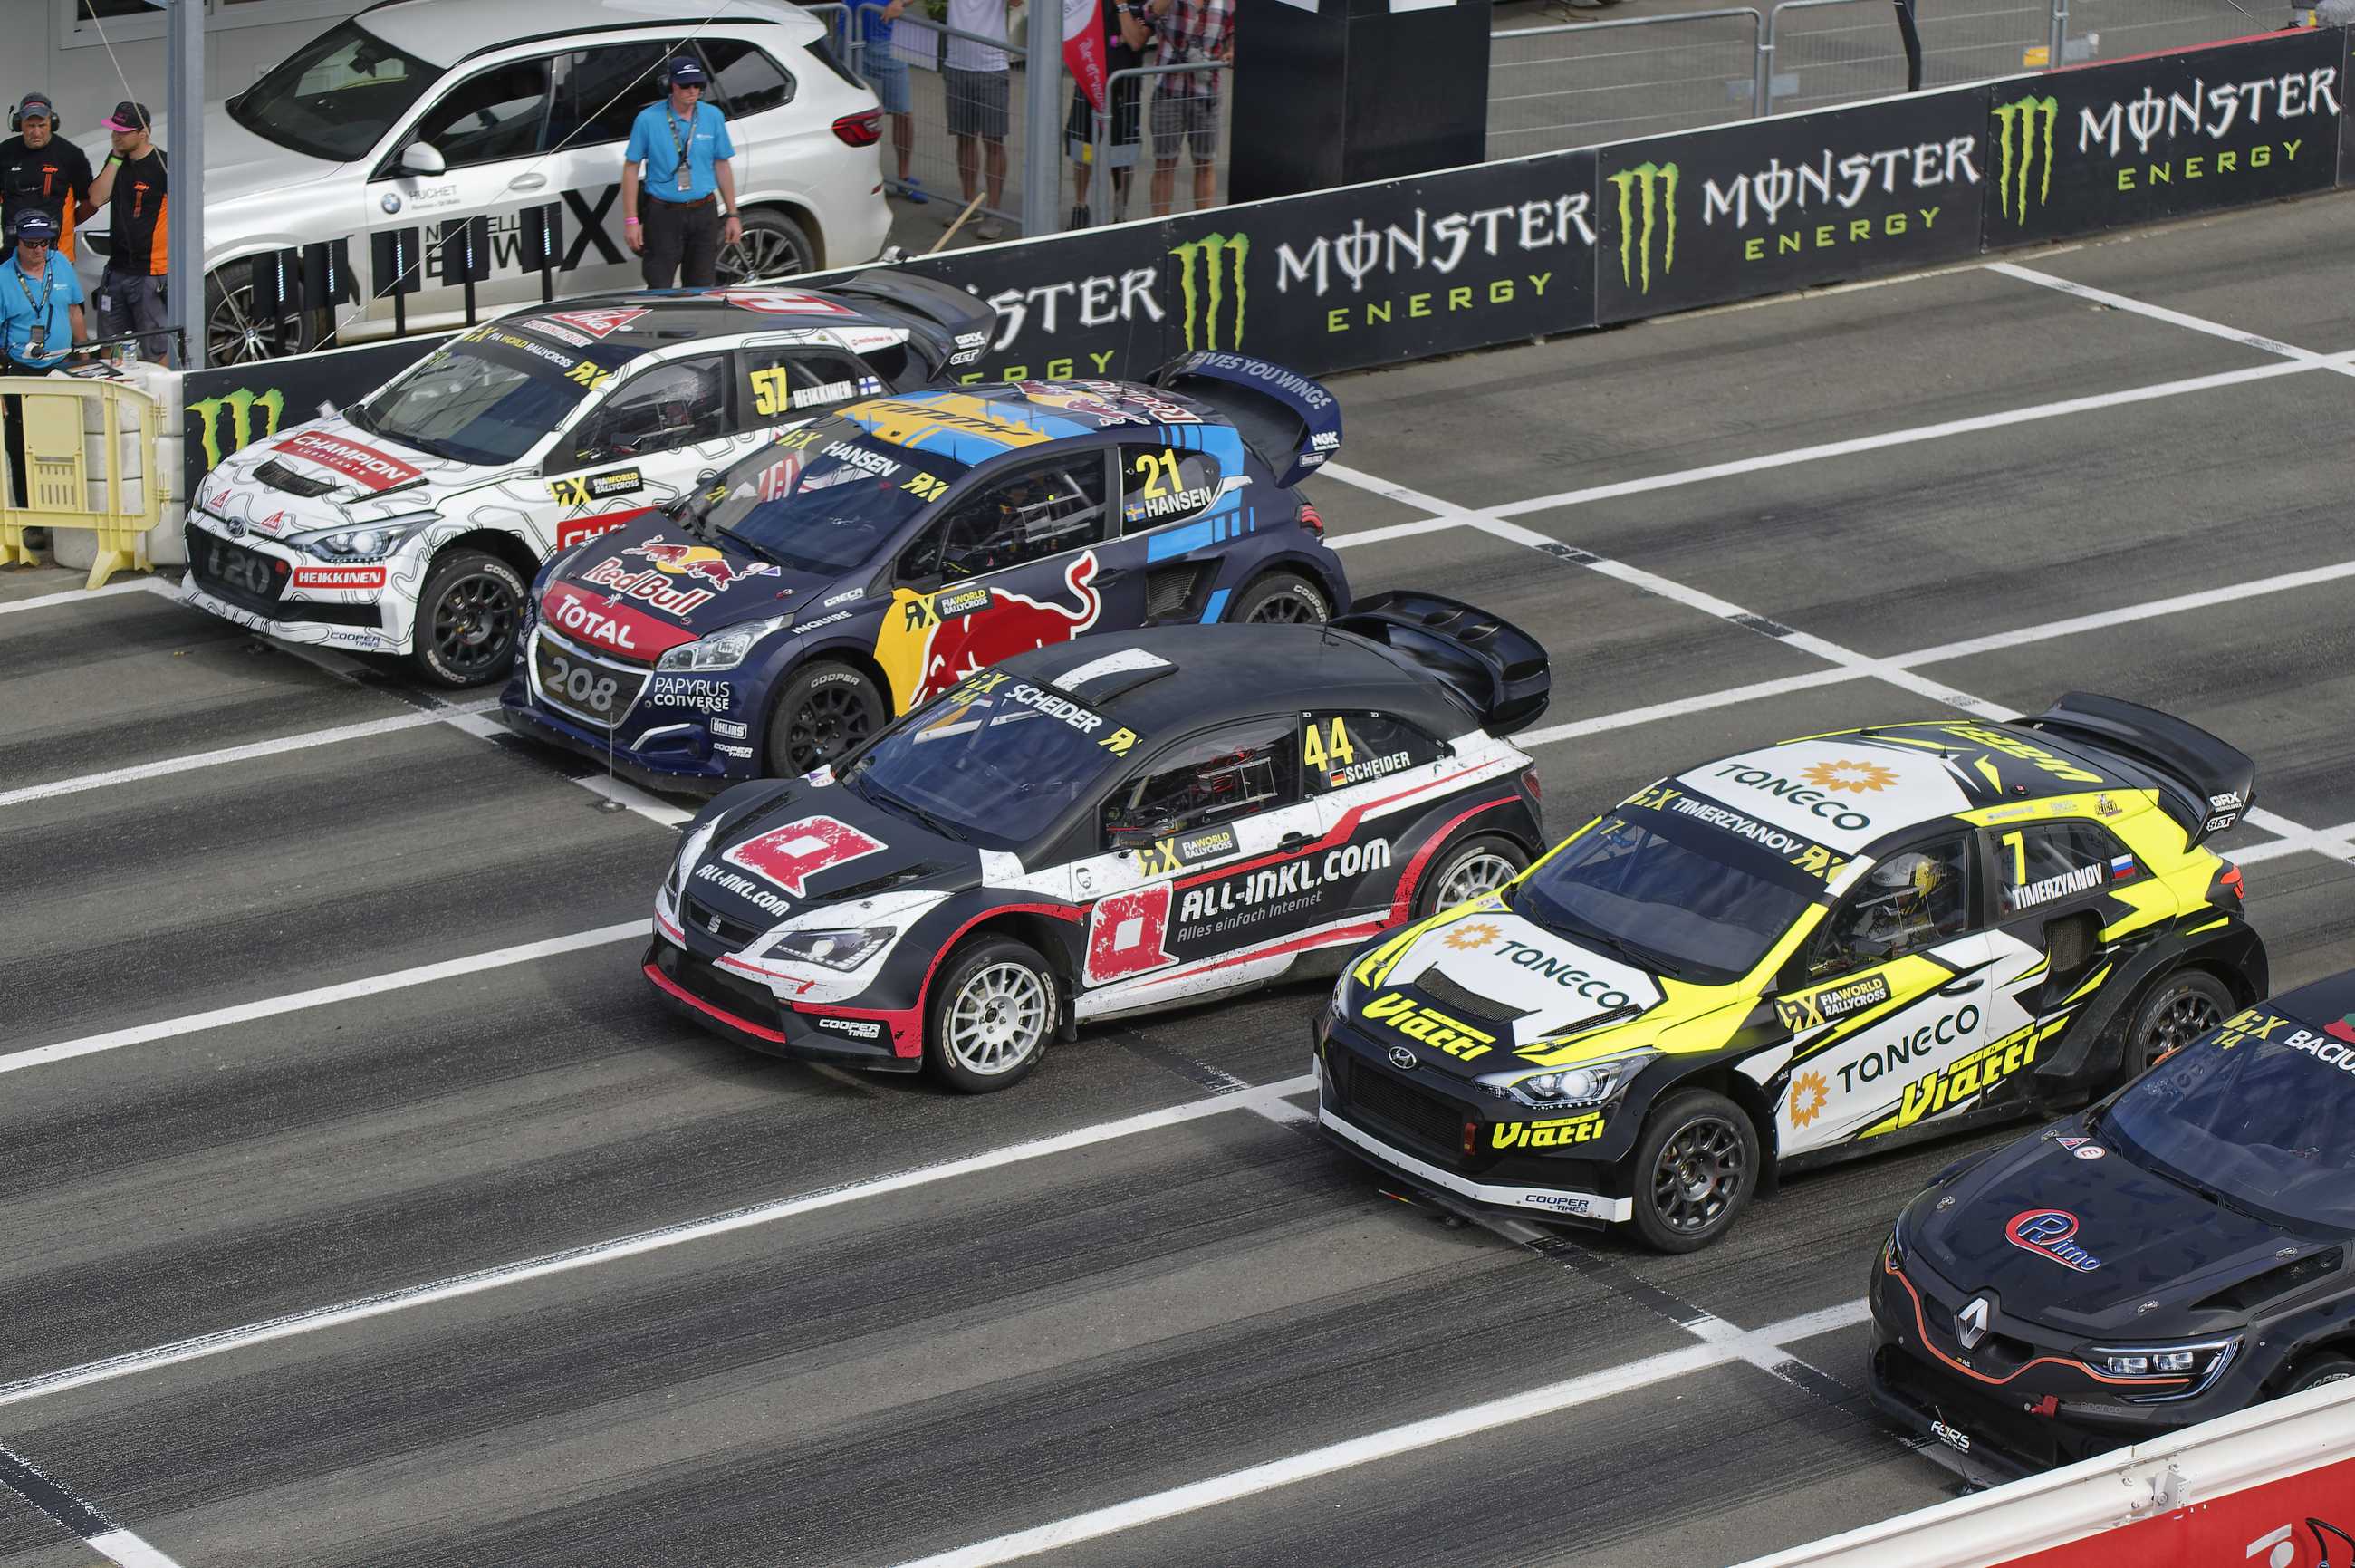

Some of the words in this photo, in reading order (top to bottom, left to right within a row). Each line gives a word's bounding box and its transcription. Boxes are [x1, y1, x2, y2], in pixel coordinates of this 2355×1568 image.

[2117, 139, 2302, 192] ENERGY
[1745, 206, 1941, 262] ENERGY
[1327, 272, 1552, 333] ENERGY
[497, 334, 529, 349] WORLD
[524, 343, 574, 369] RALLYCROSS
[750, 367, 788, 415] 57
[792, 380, 852, 409] HEIKKINEN
[1188, 351, 1244, 370] GIVES
[1239, 359, 1280, 380] YOU
[1274, 372, 1332, 409] WINGS
[1311, 431, 1339, 447] NGK
[293, 436, 408, 480] CHAMPION
[821, 441, 901, 477] HANSEN
[1136, 448, 1184, 500] 21
[594, 480, 639, 494] RALLYCROSS
[1145, 486, 1212, 518] HANSEN
[298, 572, 381, 584] HEIKKINEN
[484, 563, 525, 599] COOPER
[581, 556, 645, 592] Red
[632, 571, 716, 617] Bull
[556, 594, 636, 649] TOTAL
[943, 596, 988, 616] RALLYCROSS
[1293, 584, 1329, 623] COOPER
[330, 631, 381, 642] COOPER
[791, 611, 852, 634] INQUIRE
[546, 656, 618, 712] 208
[654, 677, 730, 698] PAPYRUS
[811, 673, 860, 688] COOPER
[1004, 684, 1103, 733] SCHEIDER
[714, 743, 754, 754] COOPER
[1303, 717, 1354, 772] 44
[1346, 751, 1411, 783] SCHEIDER
[2209, 790, 2242, 807] GRX
[1672, 797, 1803, 855] TIMERZYANOV
[1184, 841, 1233, 860] RALLYCROSS
[2002, 830, 2026, 886] 7
[696, 863, 791, 918] ALL-INKL.COM
[1179, 837, 1392, 922] ALL-INKL.COM
[2011, 861, 2102, 911] TIMERZYANOV
[1178, 922, 1212, 943] Alles
[1215, 908, 1266, 932] einfach
[1269, 890, 1322, 919] Internet
[1825, 988, 1887, 1017] RALLYCROSS
[819, 1018, 881, 1032] COOPER
[847, 1030, 879, 1038] TIRES
[2211, 1030, 2246, 1051] 14
[2283, 1029, 2355, 1079] BACIU
[1525, 1194, 1590, 1208] COOPER
[1555, 1205, 1587, 1214] TIRES
